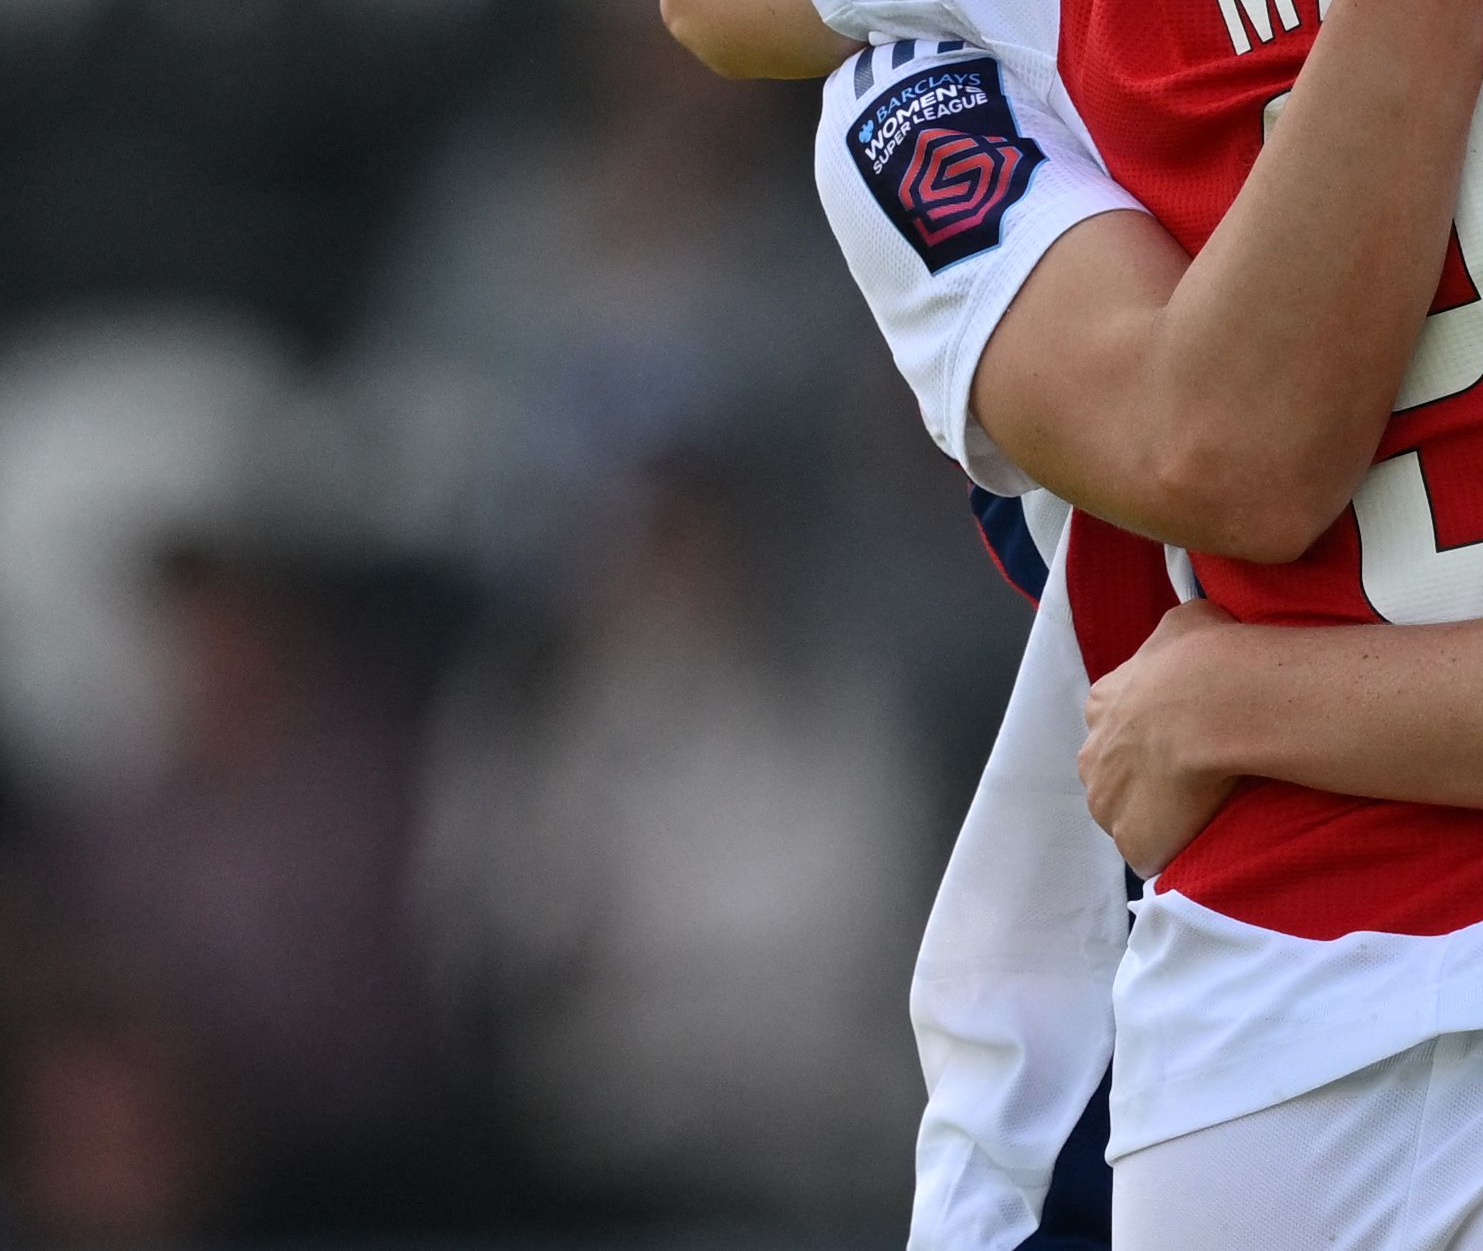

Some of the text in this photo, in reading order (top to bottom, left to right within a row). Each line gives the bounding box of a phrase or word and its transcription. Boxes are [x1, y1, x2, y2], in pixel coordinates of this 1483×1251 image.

[865, 84, 985, 161] WOMEN'S
[872, 92, 989, 175] SUPER LEAGUE
[876, 72, 981, 124] BARCLAYS
